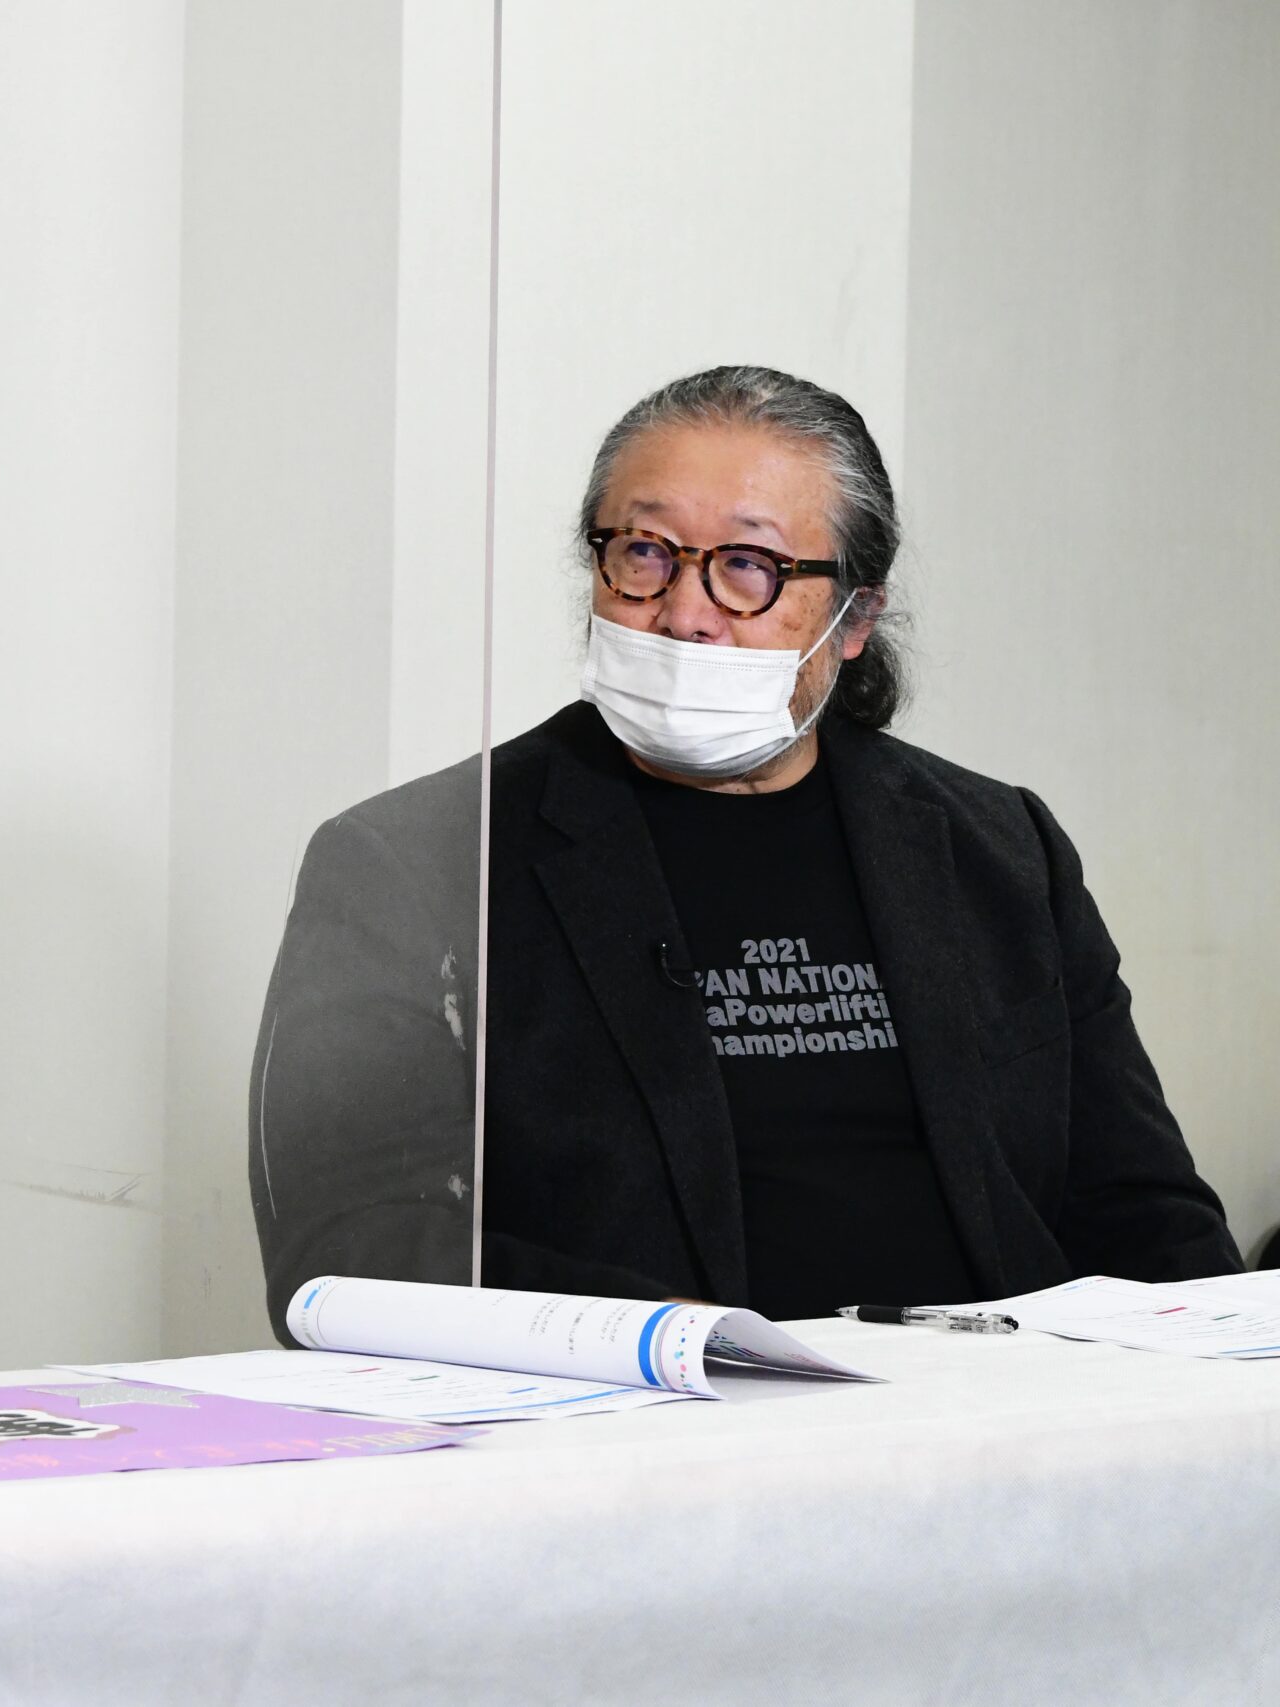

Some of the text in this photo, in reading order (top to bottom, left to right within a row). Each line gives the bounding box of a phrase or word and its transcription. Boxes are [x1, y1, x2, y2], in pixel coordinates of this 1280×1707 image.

[740, 937, 811, 964] 2021
[757, 963, 883, 995] NATION
[705, 992, 891, 1027] aPowerlifti
